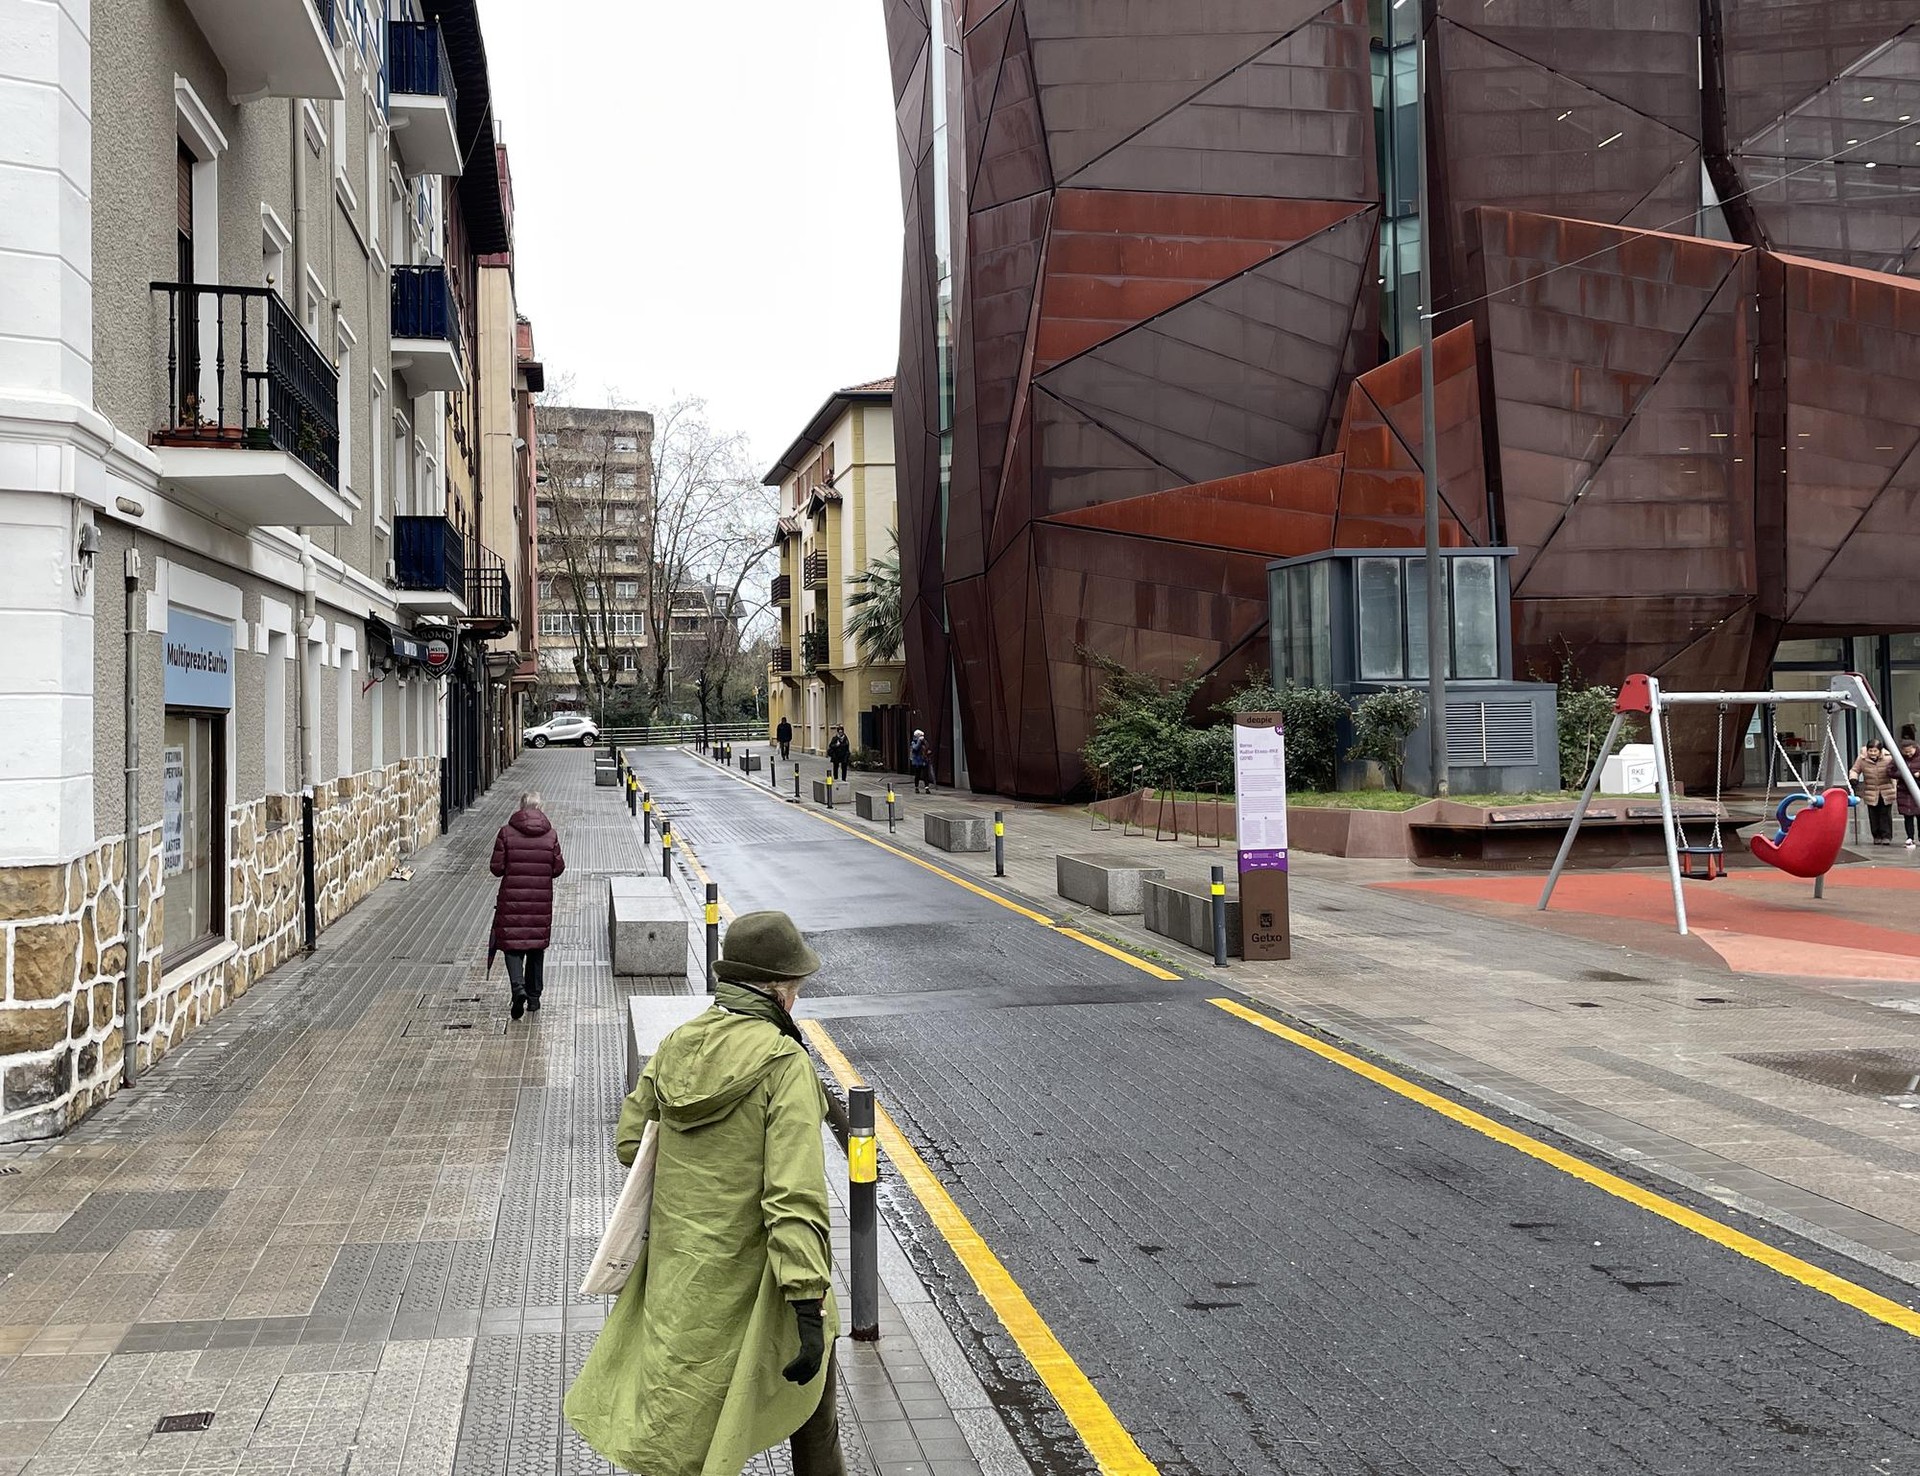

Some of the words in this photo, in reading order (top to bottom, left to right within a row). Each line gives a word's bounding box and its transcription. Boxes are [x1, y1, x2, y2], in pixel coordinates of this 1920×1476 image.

[167, 643, 207, 673] Multiprezio
[208, 650, 227, 674] Eurito
[1251, 933, 1282, 943] Getxo
